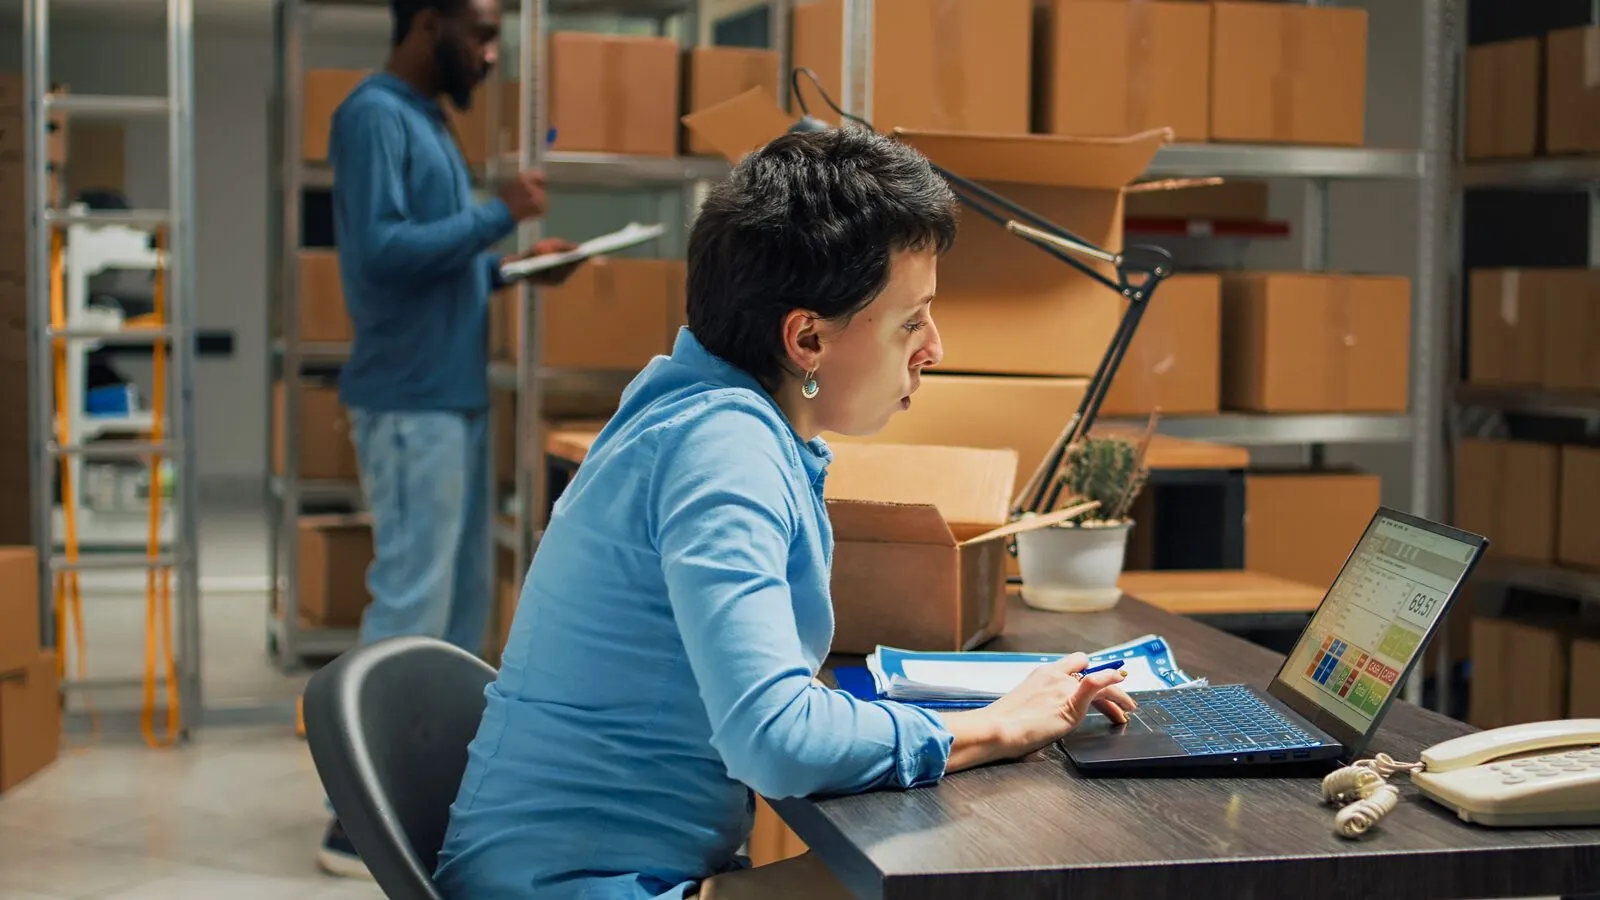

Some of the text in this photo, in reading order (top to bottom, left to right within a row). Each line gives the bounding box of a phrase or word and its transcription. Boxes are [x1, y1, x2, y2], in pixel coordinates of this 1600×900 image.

[1408, 593, 1437, 618] 69.51
[1368, 661, 1396, 682] CASH CARD
